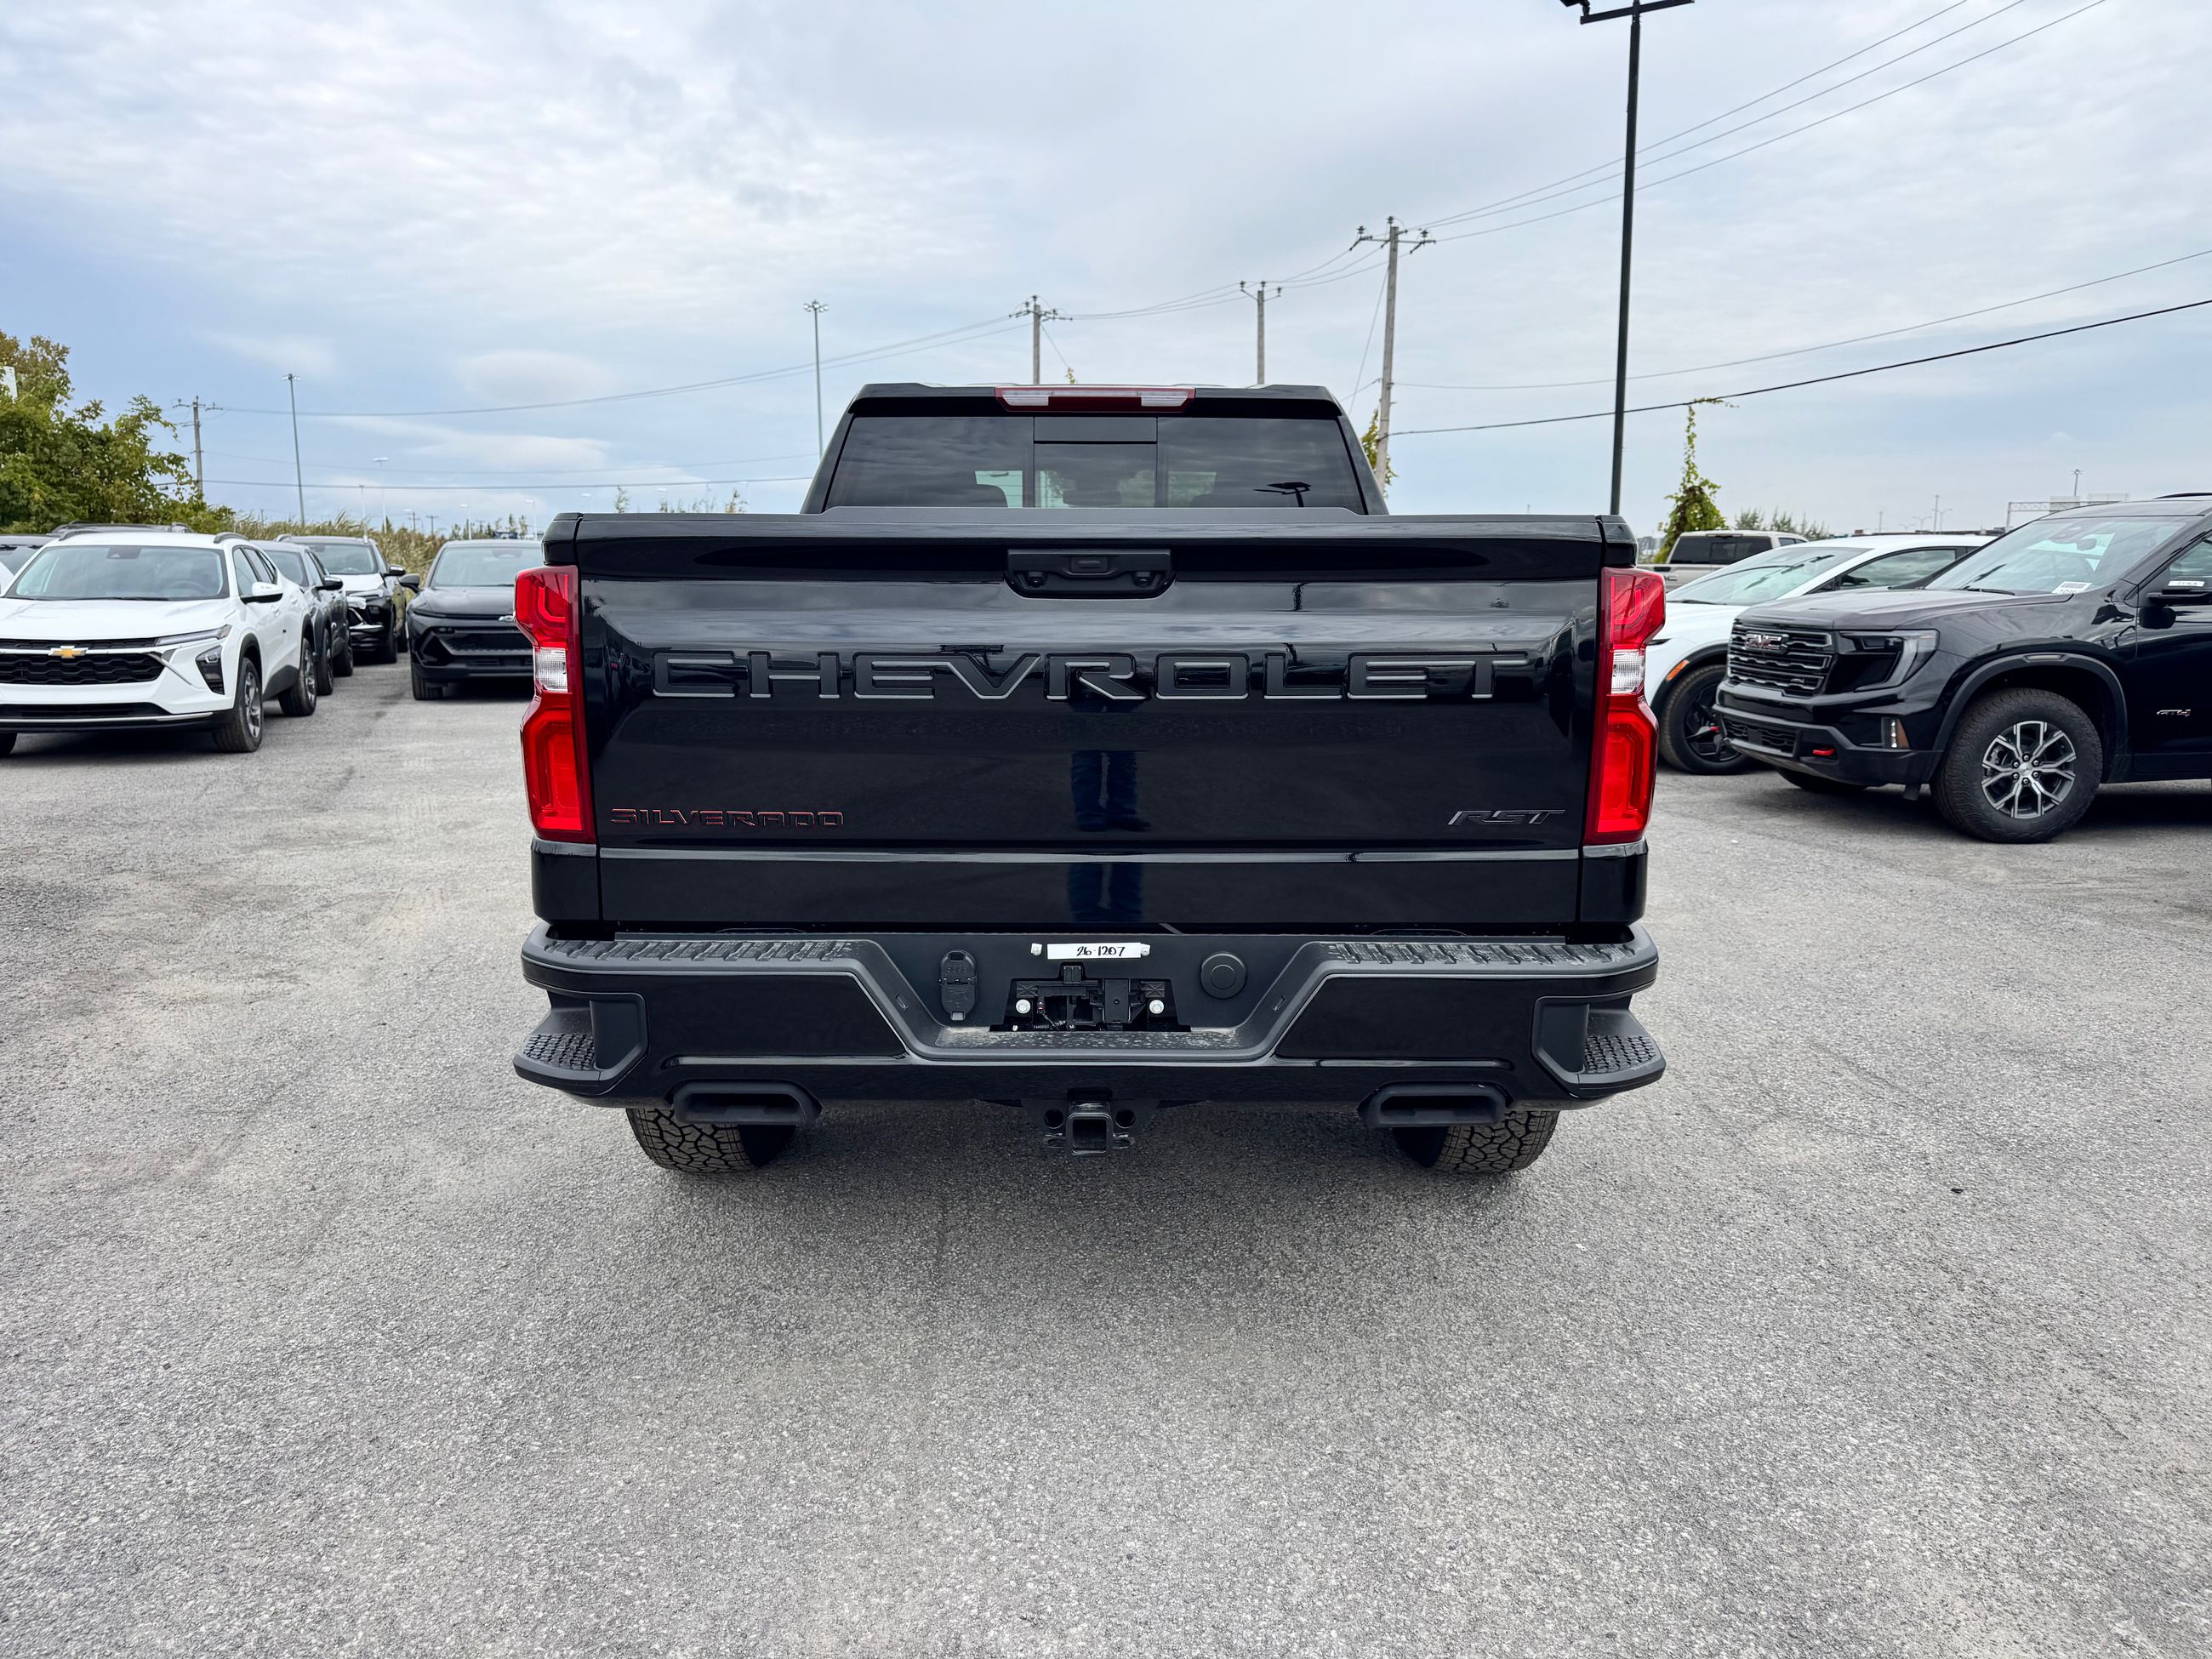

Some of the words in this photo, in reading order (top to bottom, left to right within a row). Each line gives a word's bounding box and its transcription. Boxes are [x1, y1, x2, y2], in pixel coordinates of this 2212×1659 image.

[1745, 634, 1782, 650] GMC
[652, 651, 1529, 699] CHEVROLET
[611, 808, 844, 827] SILVERADO
[1447, 809, 1566, 825] RST
